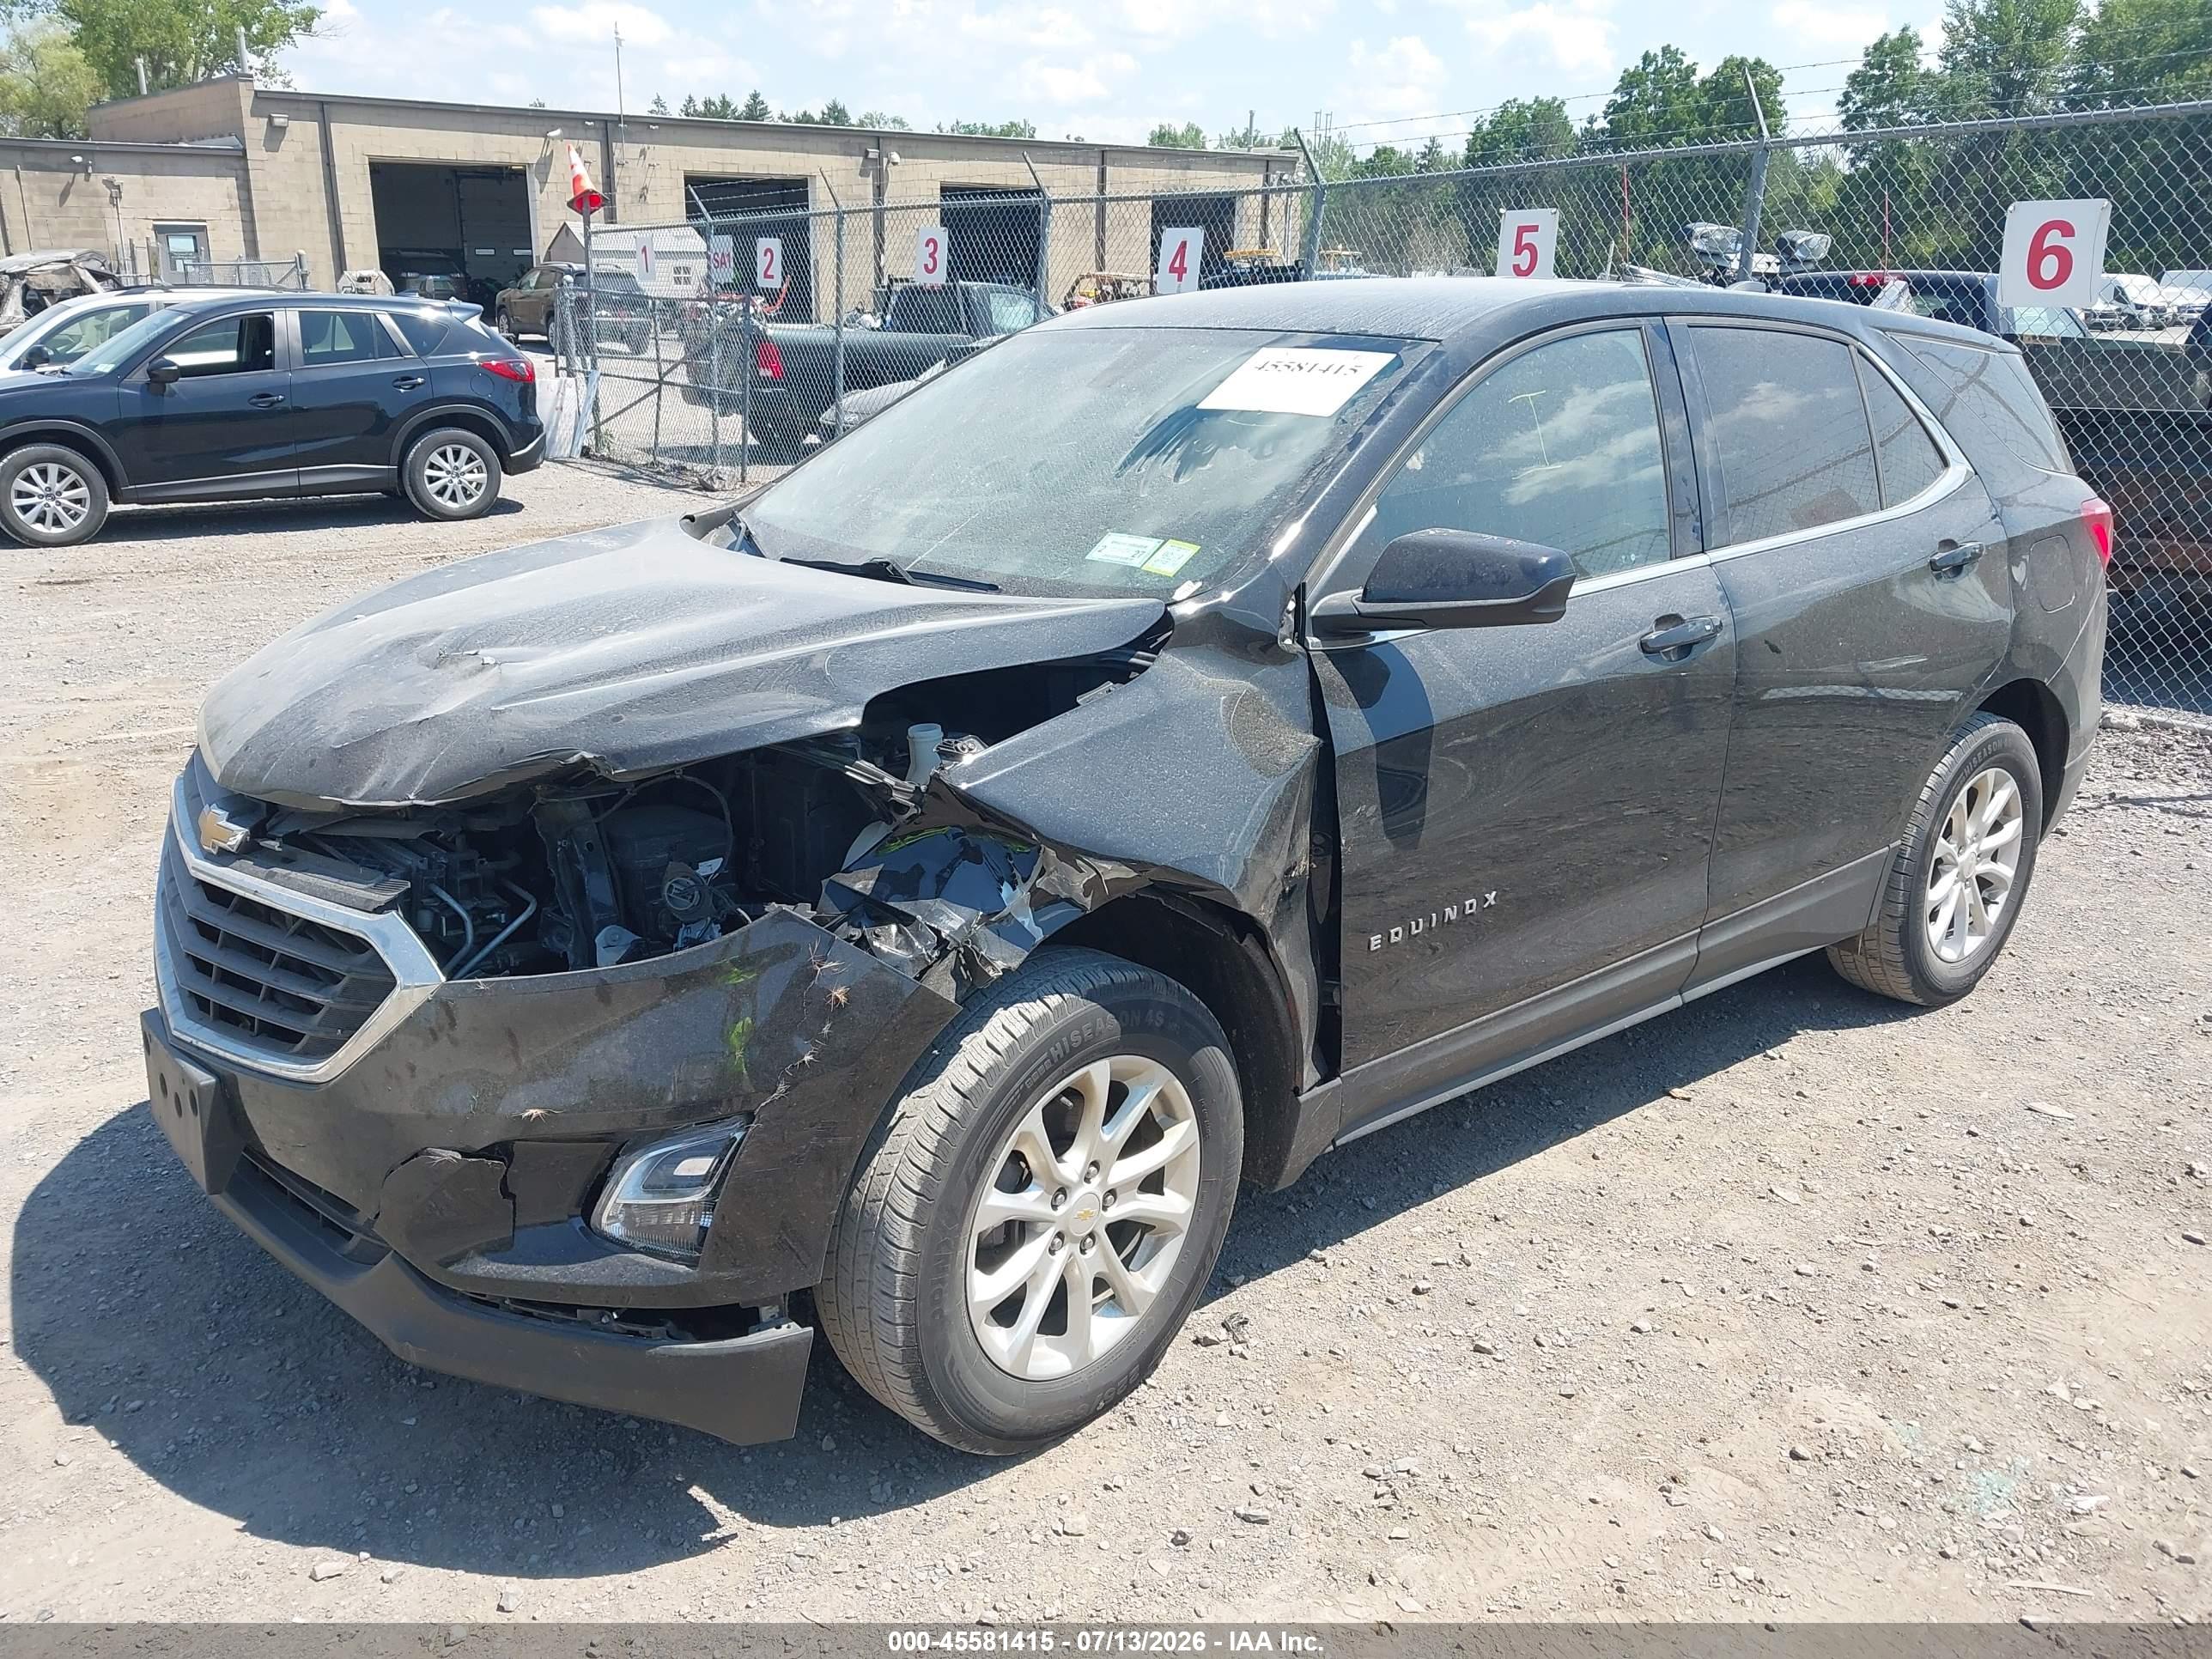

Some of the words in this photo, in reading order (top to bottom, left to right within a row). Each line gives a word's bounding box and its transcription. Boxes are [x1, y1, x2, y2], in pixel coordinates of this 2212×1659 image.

[641, 244, 649, 274] 1
[763, 246, 775, 280] 2
[923, 237, 939, 275] 3
[1168, 240, 1188, 283] 4
[1512, 224, 1540, 277] 5
[2027, 219, 2076, 291] 6
[1369, 890, 1498, 951] EQUINOX
